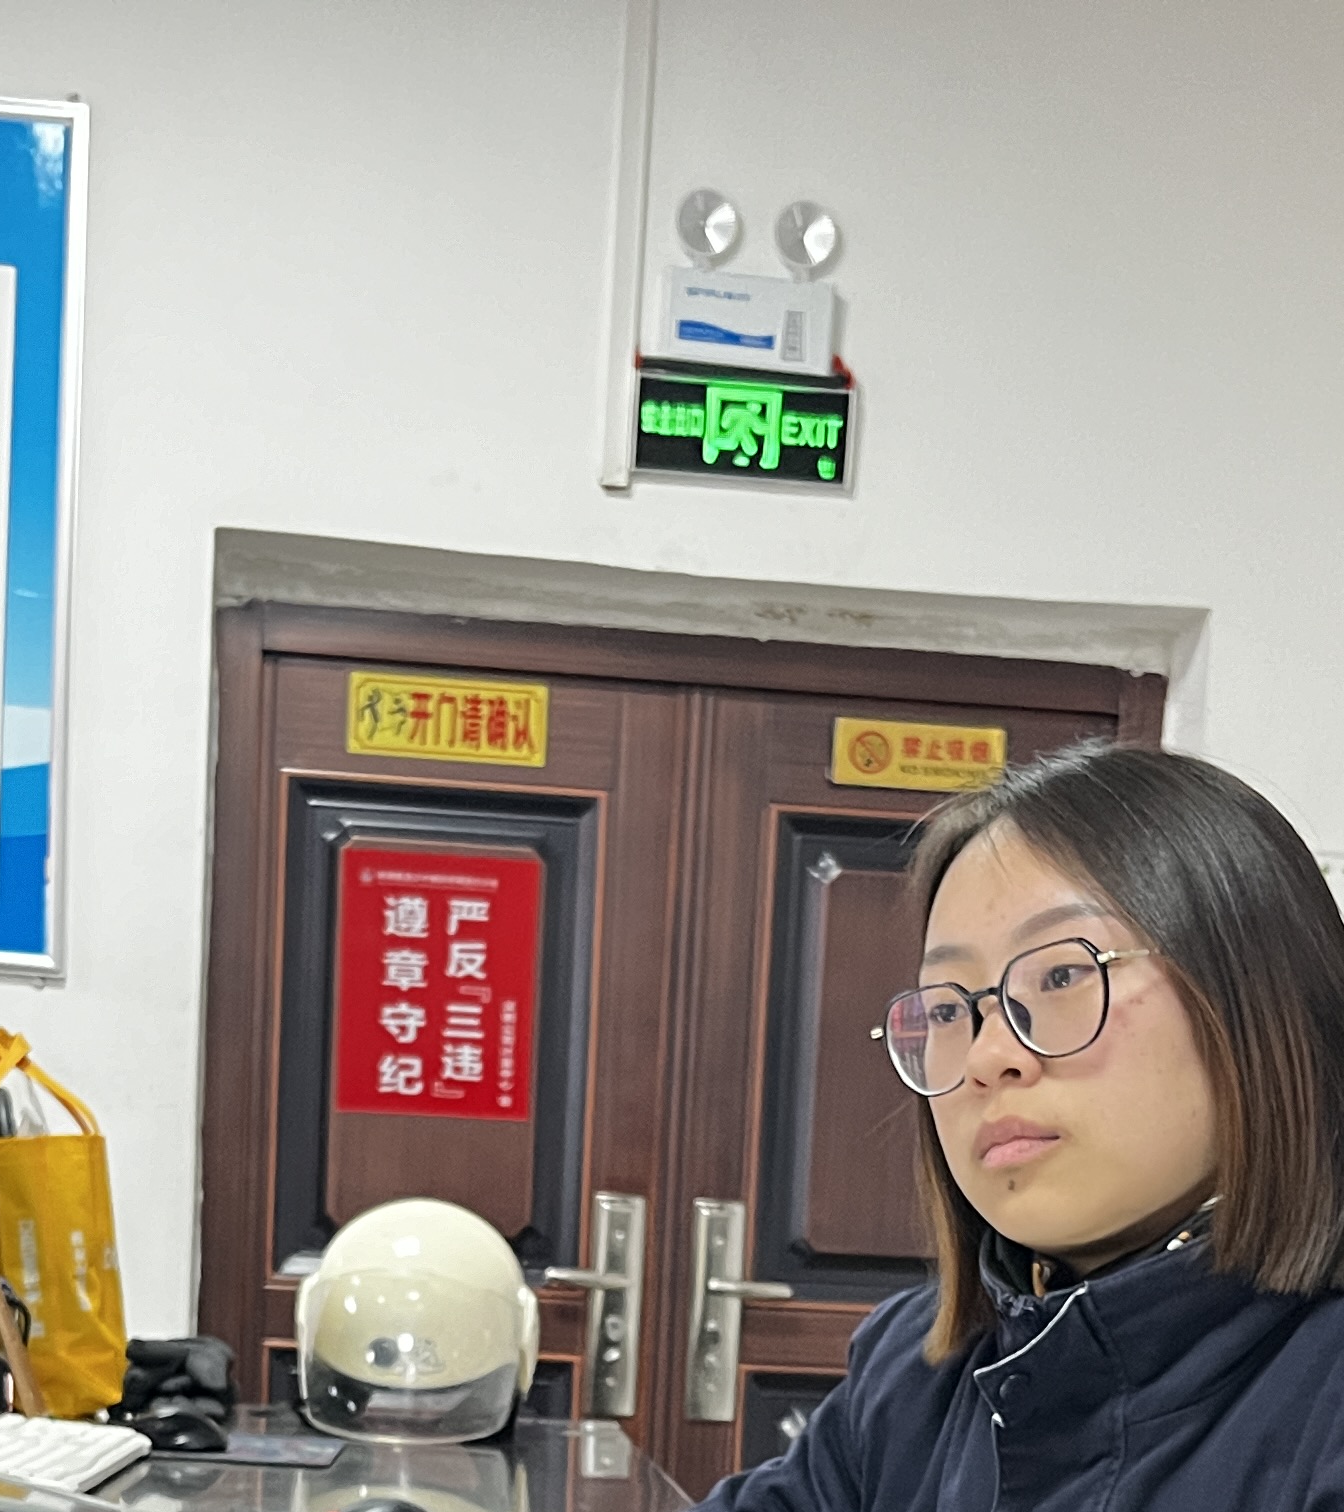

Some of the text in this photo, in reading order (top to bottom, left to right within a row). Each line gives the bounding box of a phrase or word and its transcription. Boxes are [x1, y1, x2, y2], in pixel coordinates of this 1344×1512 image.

[781, 412, 844, 449] EXIT
[408, 692, 537, 754] 开门请确认
[377, 895, 430, 1096] 遵章守纪
